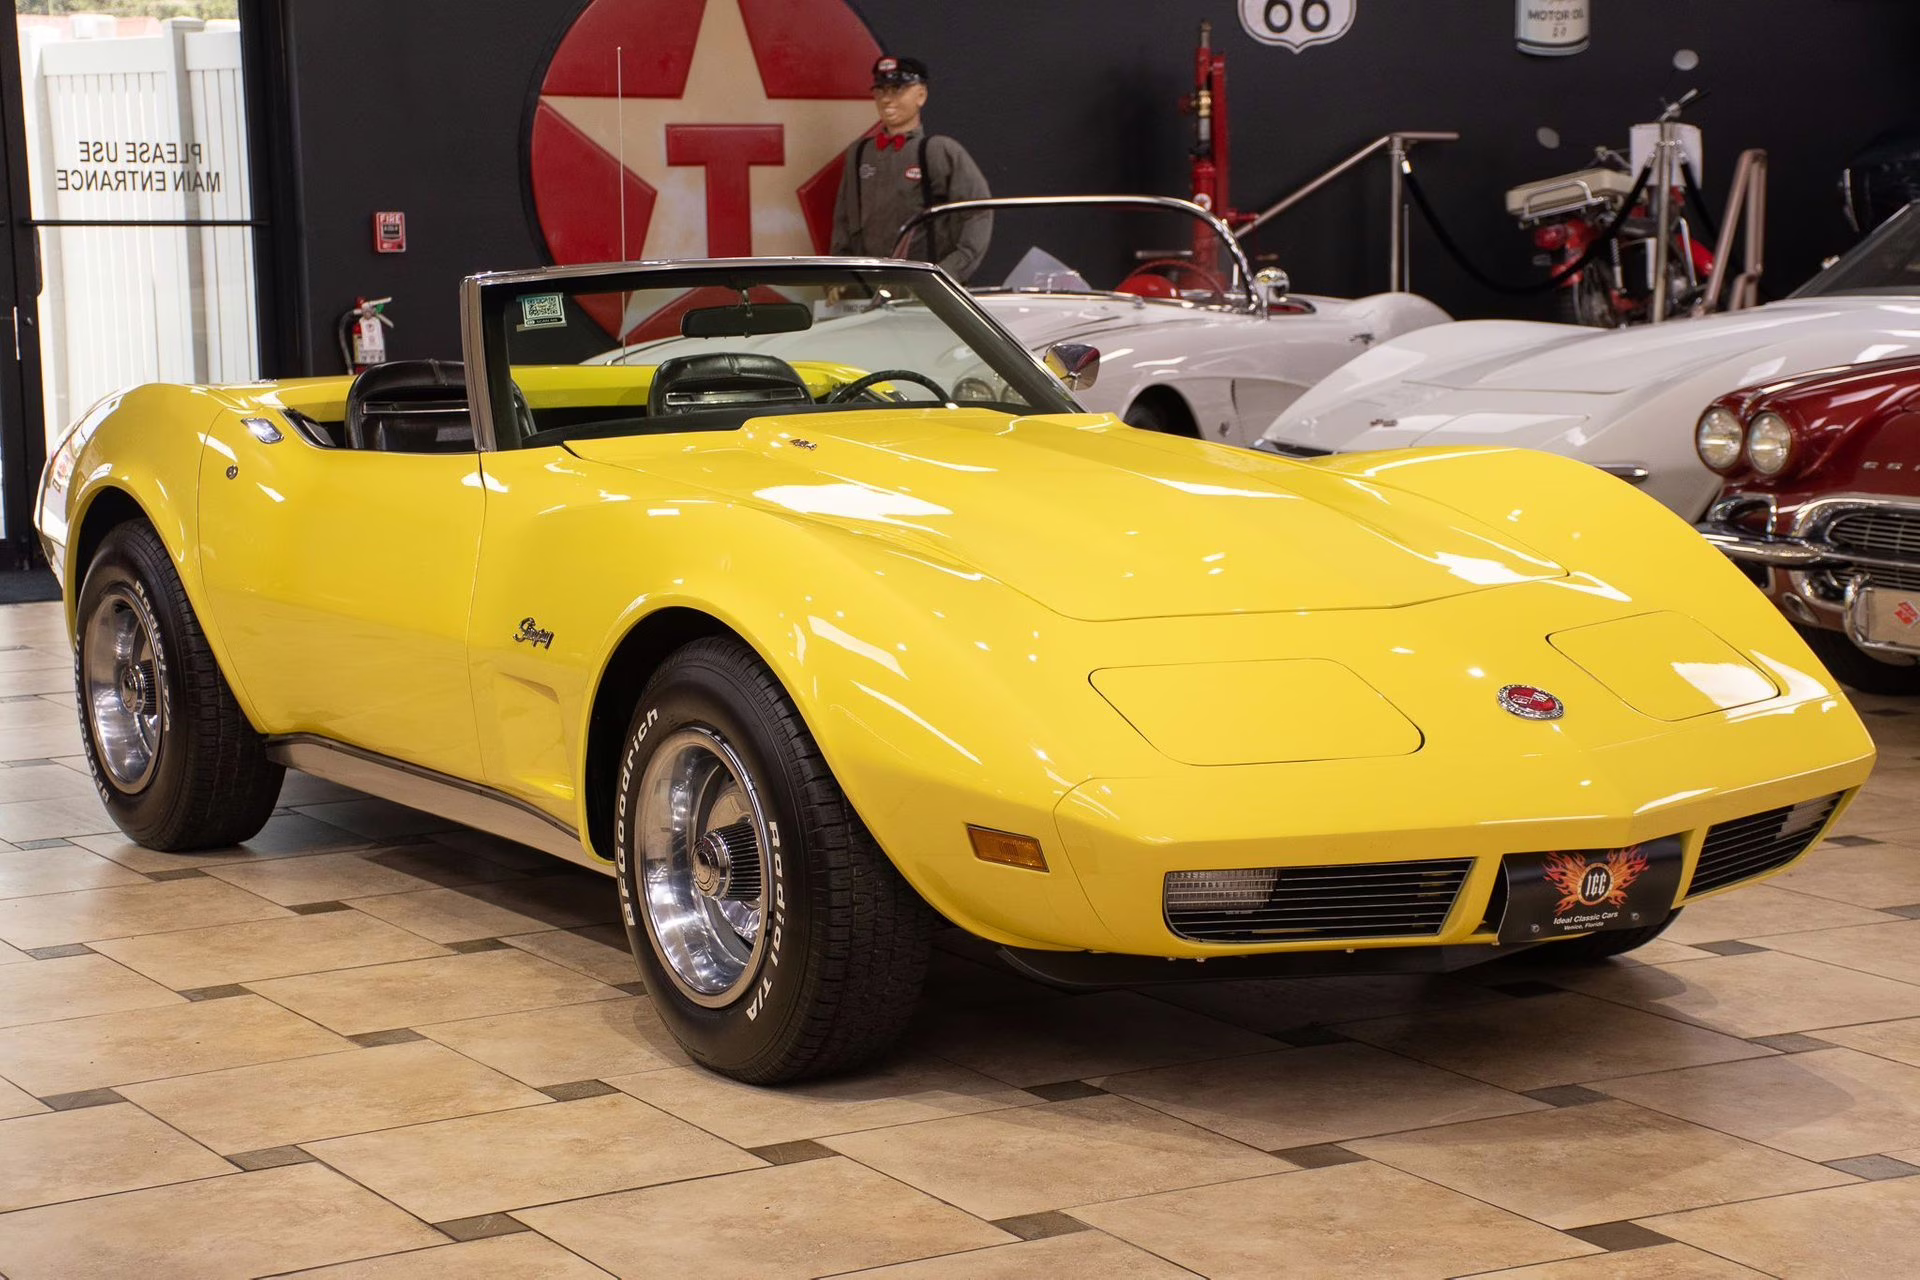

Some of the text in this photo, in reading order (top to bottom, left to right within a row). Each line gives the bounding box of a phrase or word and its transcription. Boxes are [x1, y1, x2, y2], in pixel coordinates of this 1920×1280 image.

[379, 213, 401, 224] FIRE
[665, 123, 785, 259] T
[617, 708, 659, 926] BFGoodrich
[745, 821, 786, 1021] Radial T/A
[1553, 911, 1619, 925] Ideal Classic Cars
[1584, 921, 1605, 929] Florida
